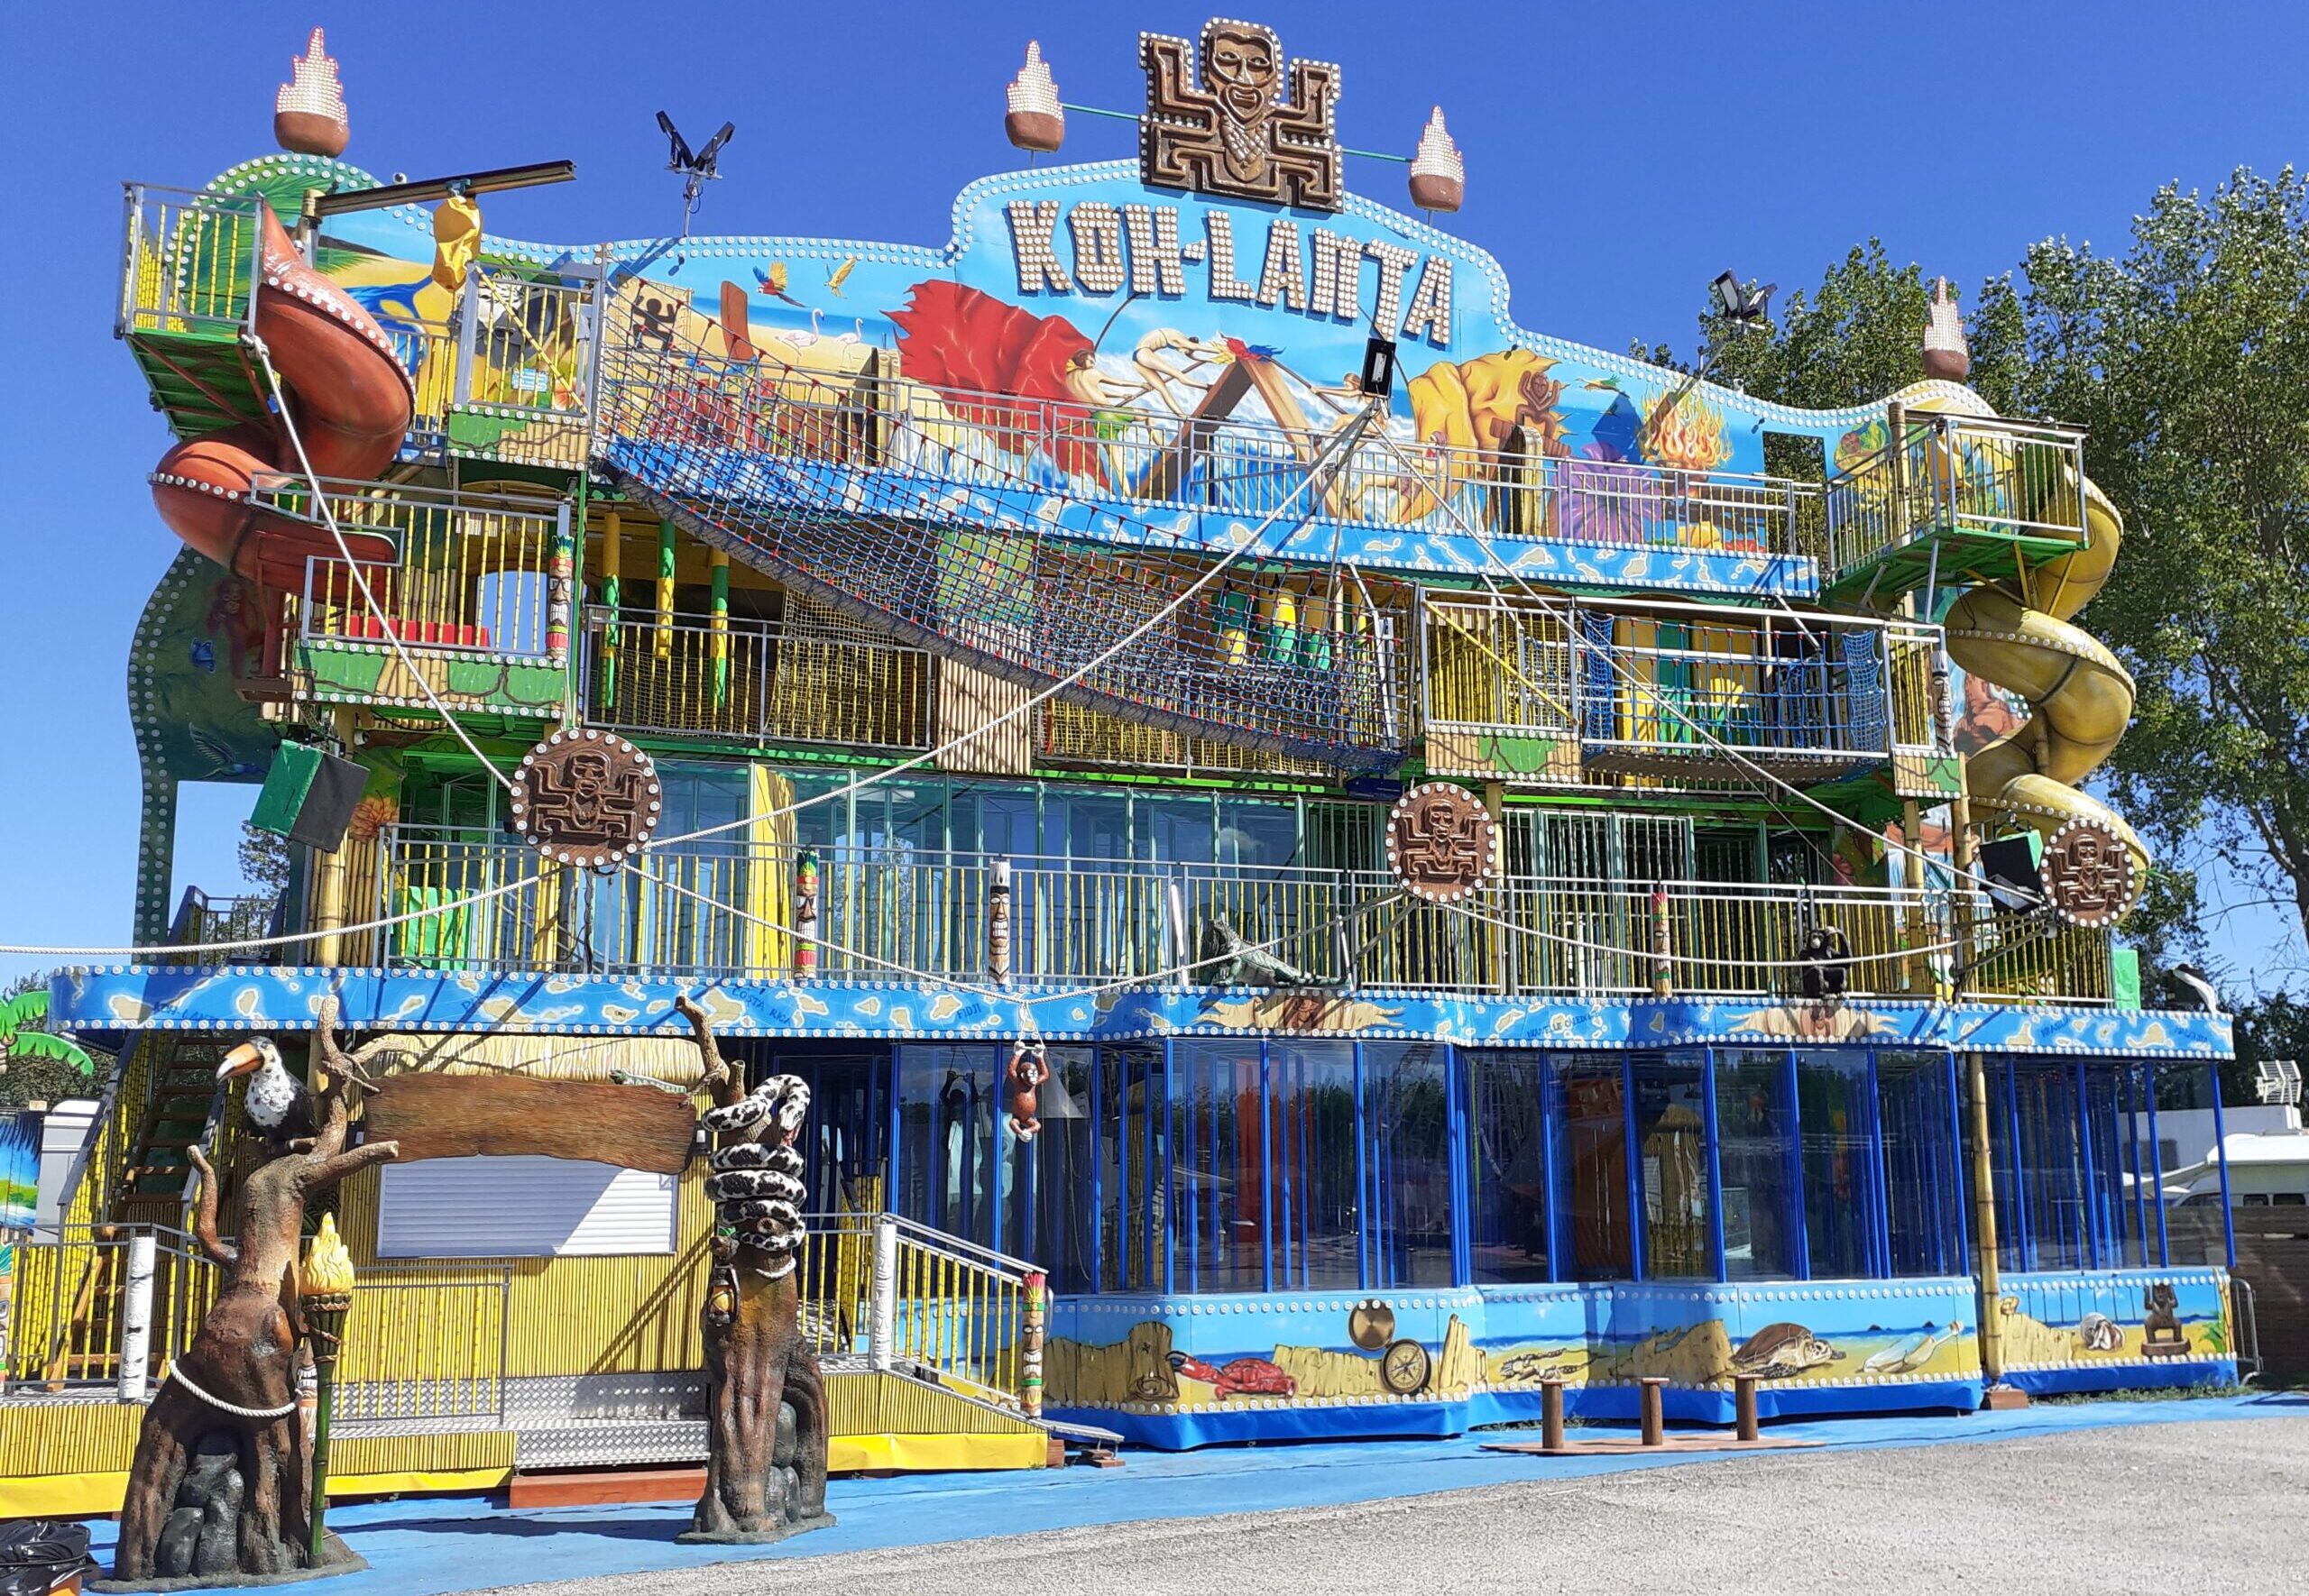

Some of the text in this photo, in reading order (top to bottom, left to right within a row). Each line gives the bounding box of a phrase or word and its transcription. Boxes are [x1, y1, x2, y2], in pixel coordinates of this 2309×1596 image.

[1007, 199, 1452, 345] KOH-LANTA
[731, 987, 765, 1011] COSTA
[152, 1001, 217, 1024] KOH-LANT
[957, 1004, 981, 1019] FIDJI
